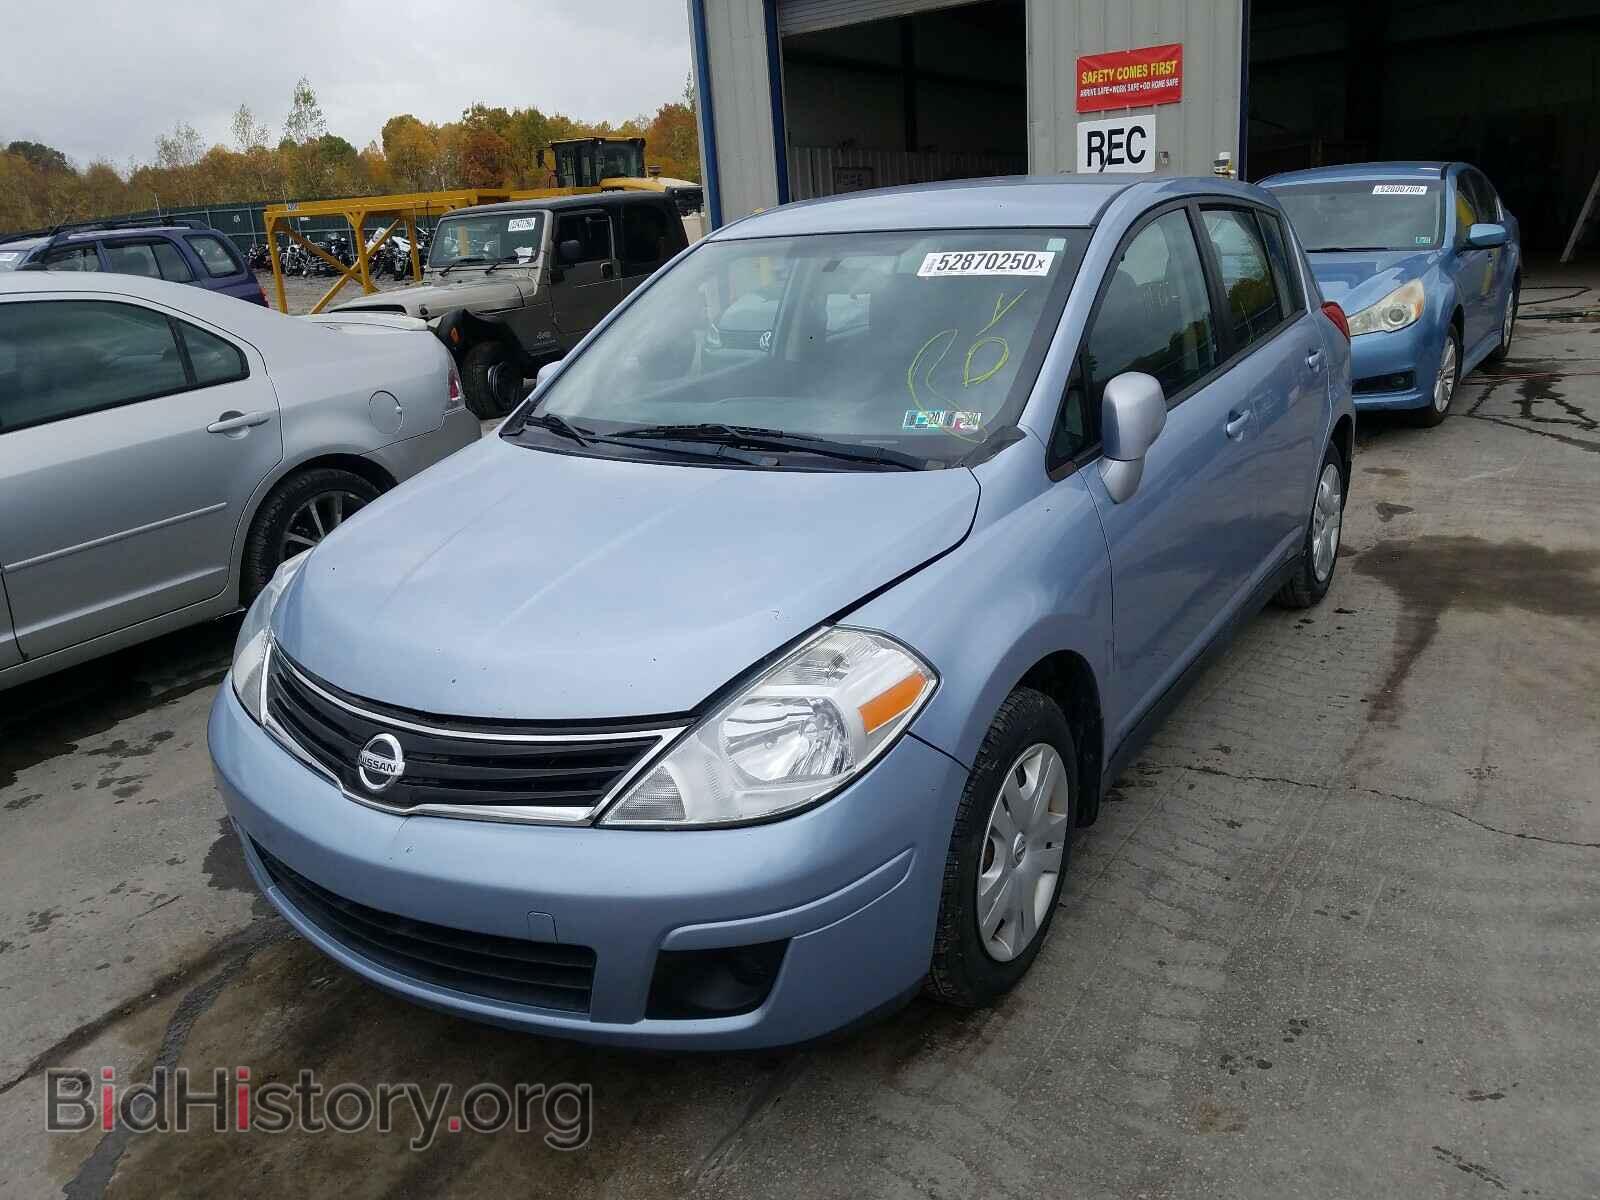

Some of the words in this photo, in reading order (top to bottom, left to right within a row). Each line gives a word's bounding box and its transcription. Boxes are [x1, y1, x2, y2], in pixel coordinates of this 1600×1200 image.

[1081, 69, 1115, 85] SAFETY
[1116, 64, 1148, 80] COMES
[1150, 60, 1178, 76] FIRST
[1086, 125, 1147, 168] REC
[360, 754, 397, 773] NISSAN
